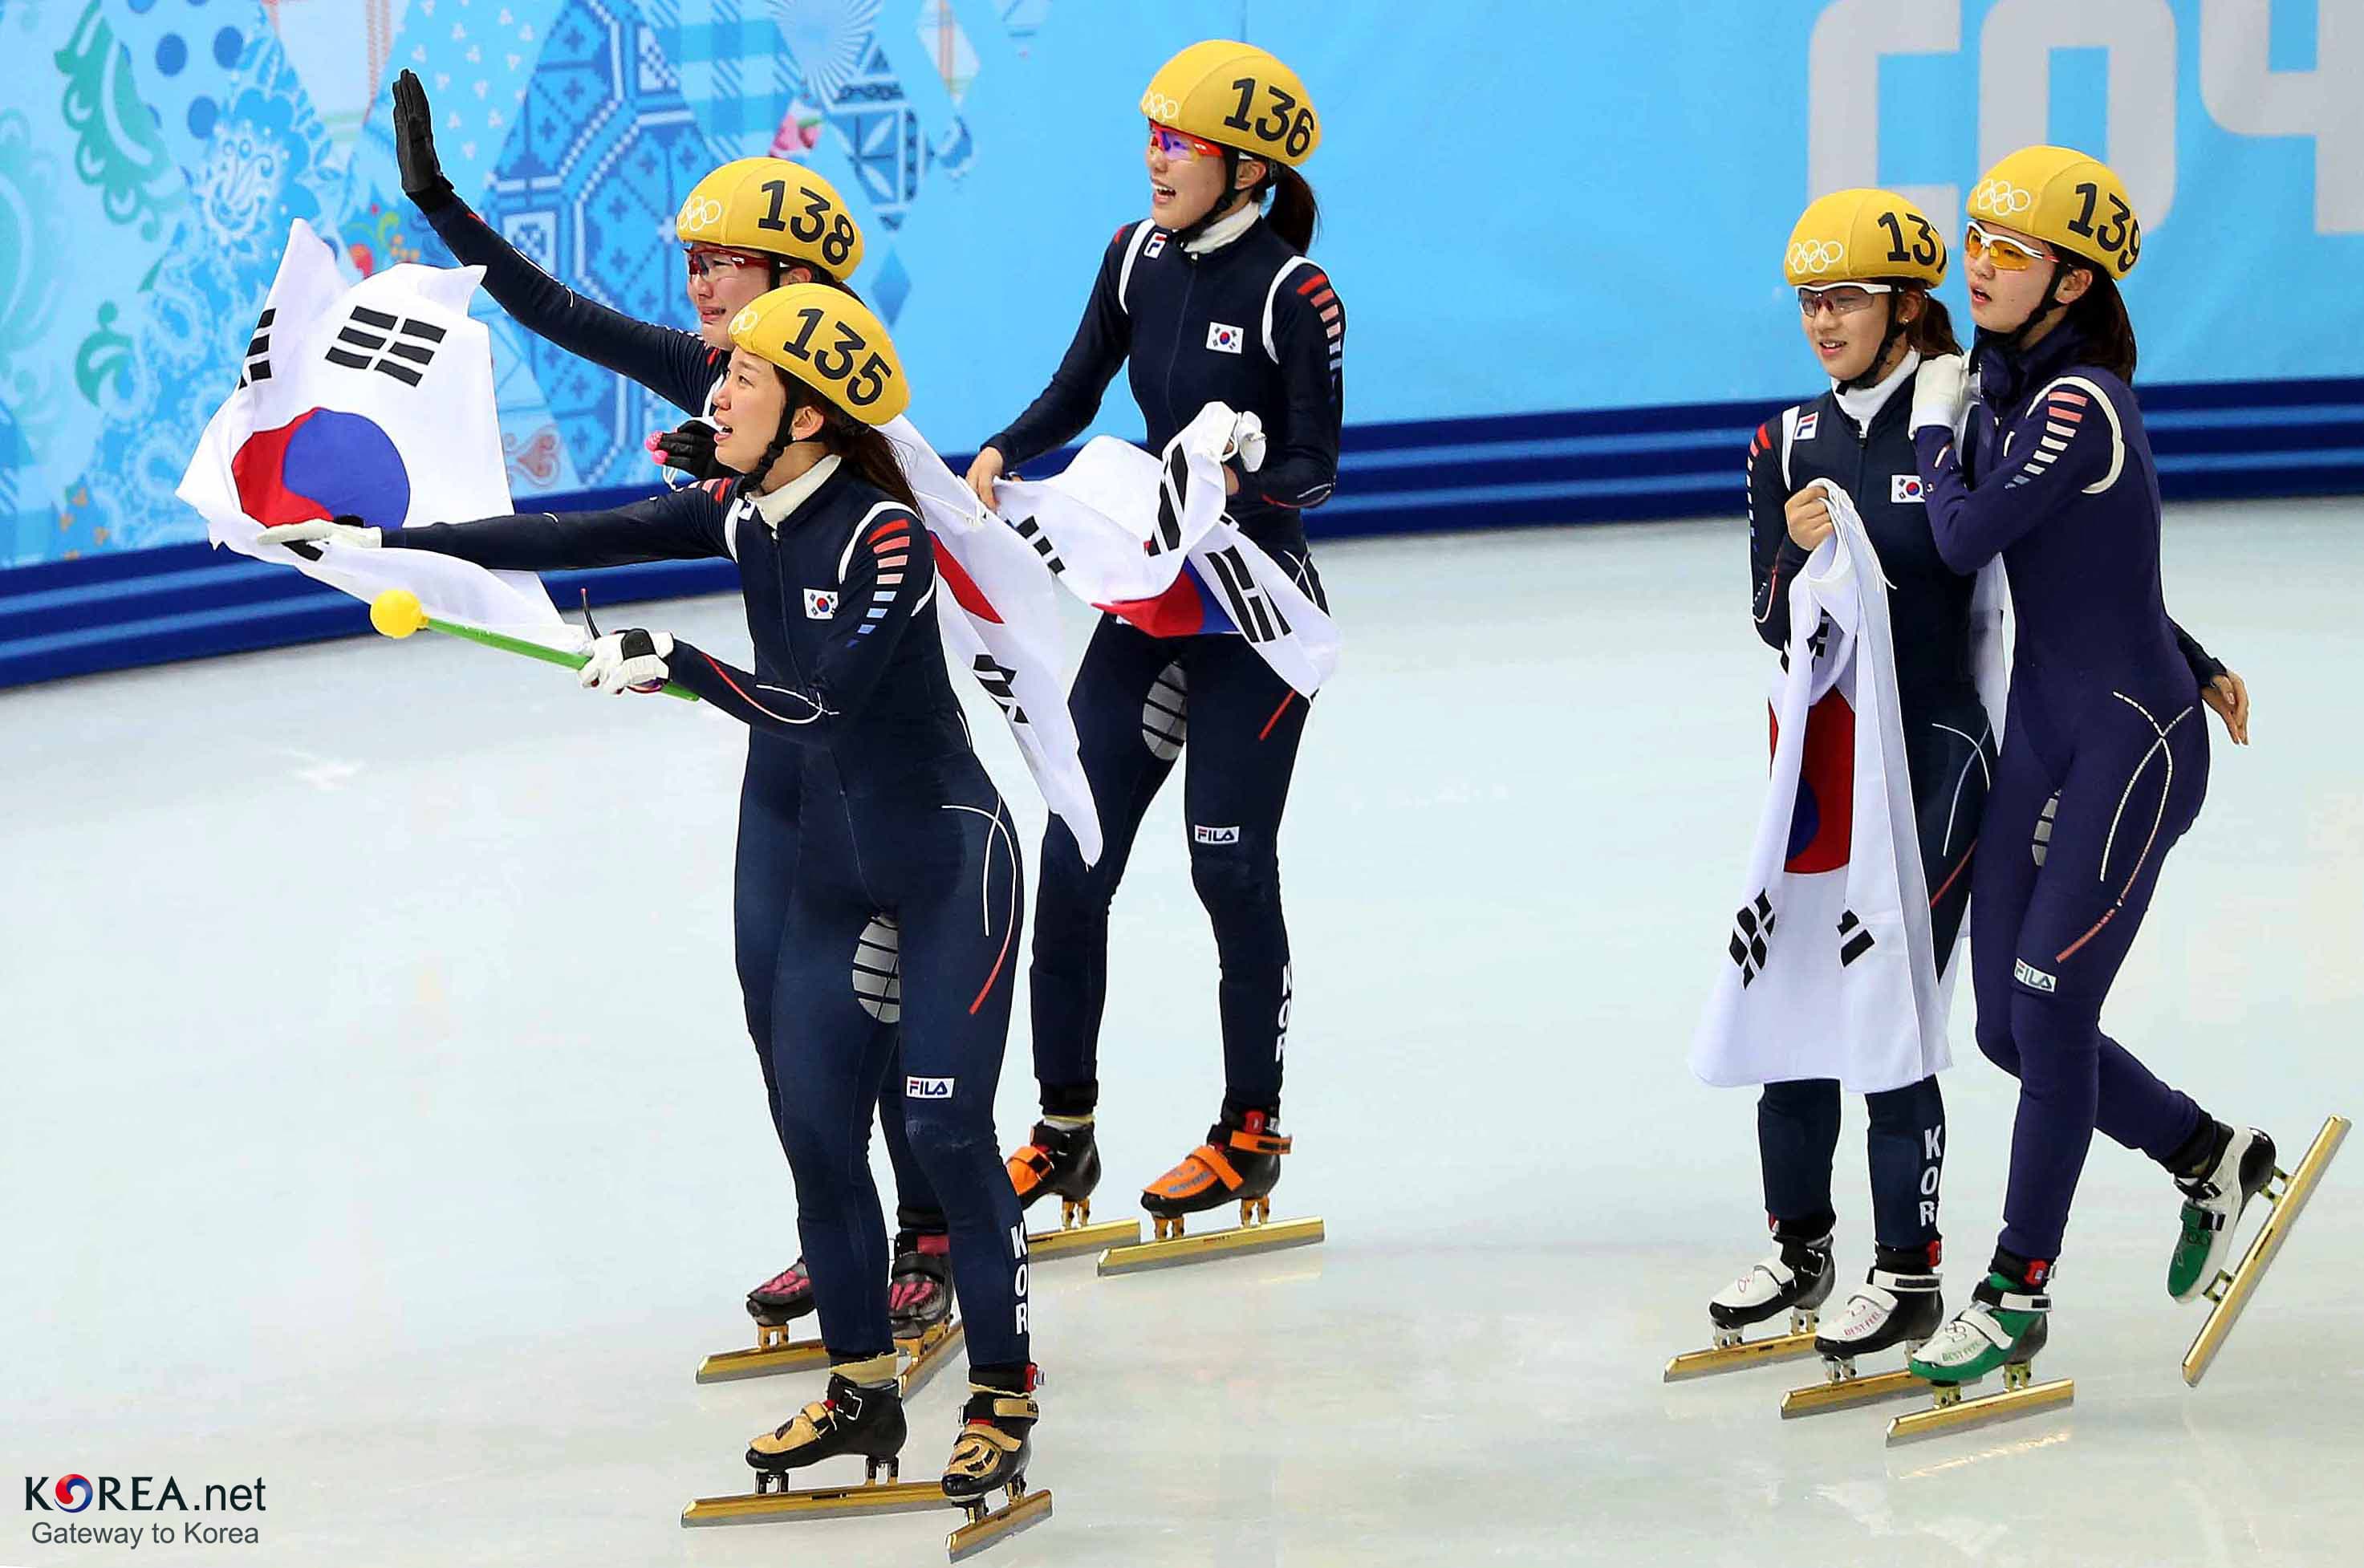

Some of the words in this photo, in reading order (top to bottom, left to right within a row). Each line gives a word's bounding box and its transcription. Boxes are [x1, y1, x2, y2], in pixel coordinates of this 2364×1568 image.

[1224, 78, 1314, 157] 136
[758, 180, 855, 266] 138
[2067, 183, 2140, 272] 139
[782, 309, 892, 406] 135
[1196, 828, 1234, 841] FILA
[2016, 961, 2053, 989] FILA
[909, 1080, 948, 1095] FILA
[1919, 1124, 1941, 1227] KOR
[1010, 1221, 1028, 1335] KOR
